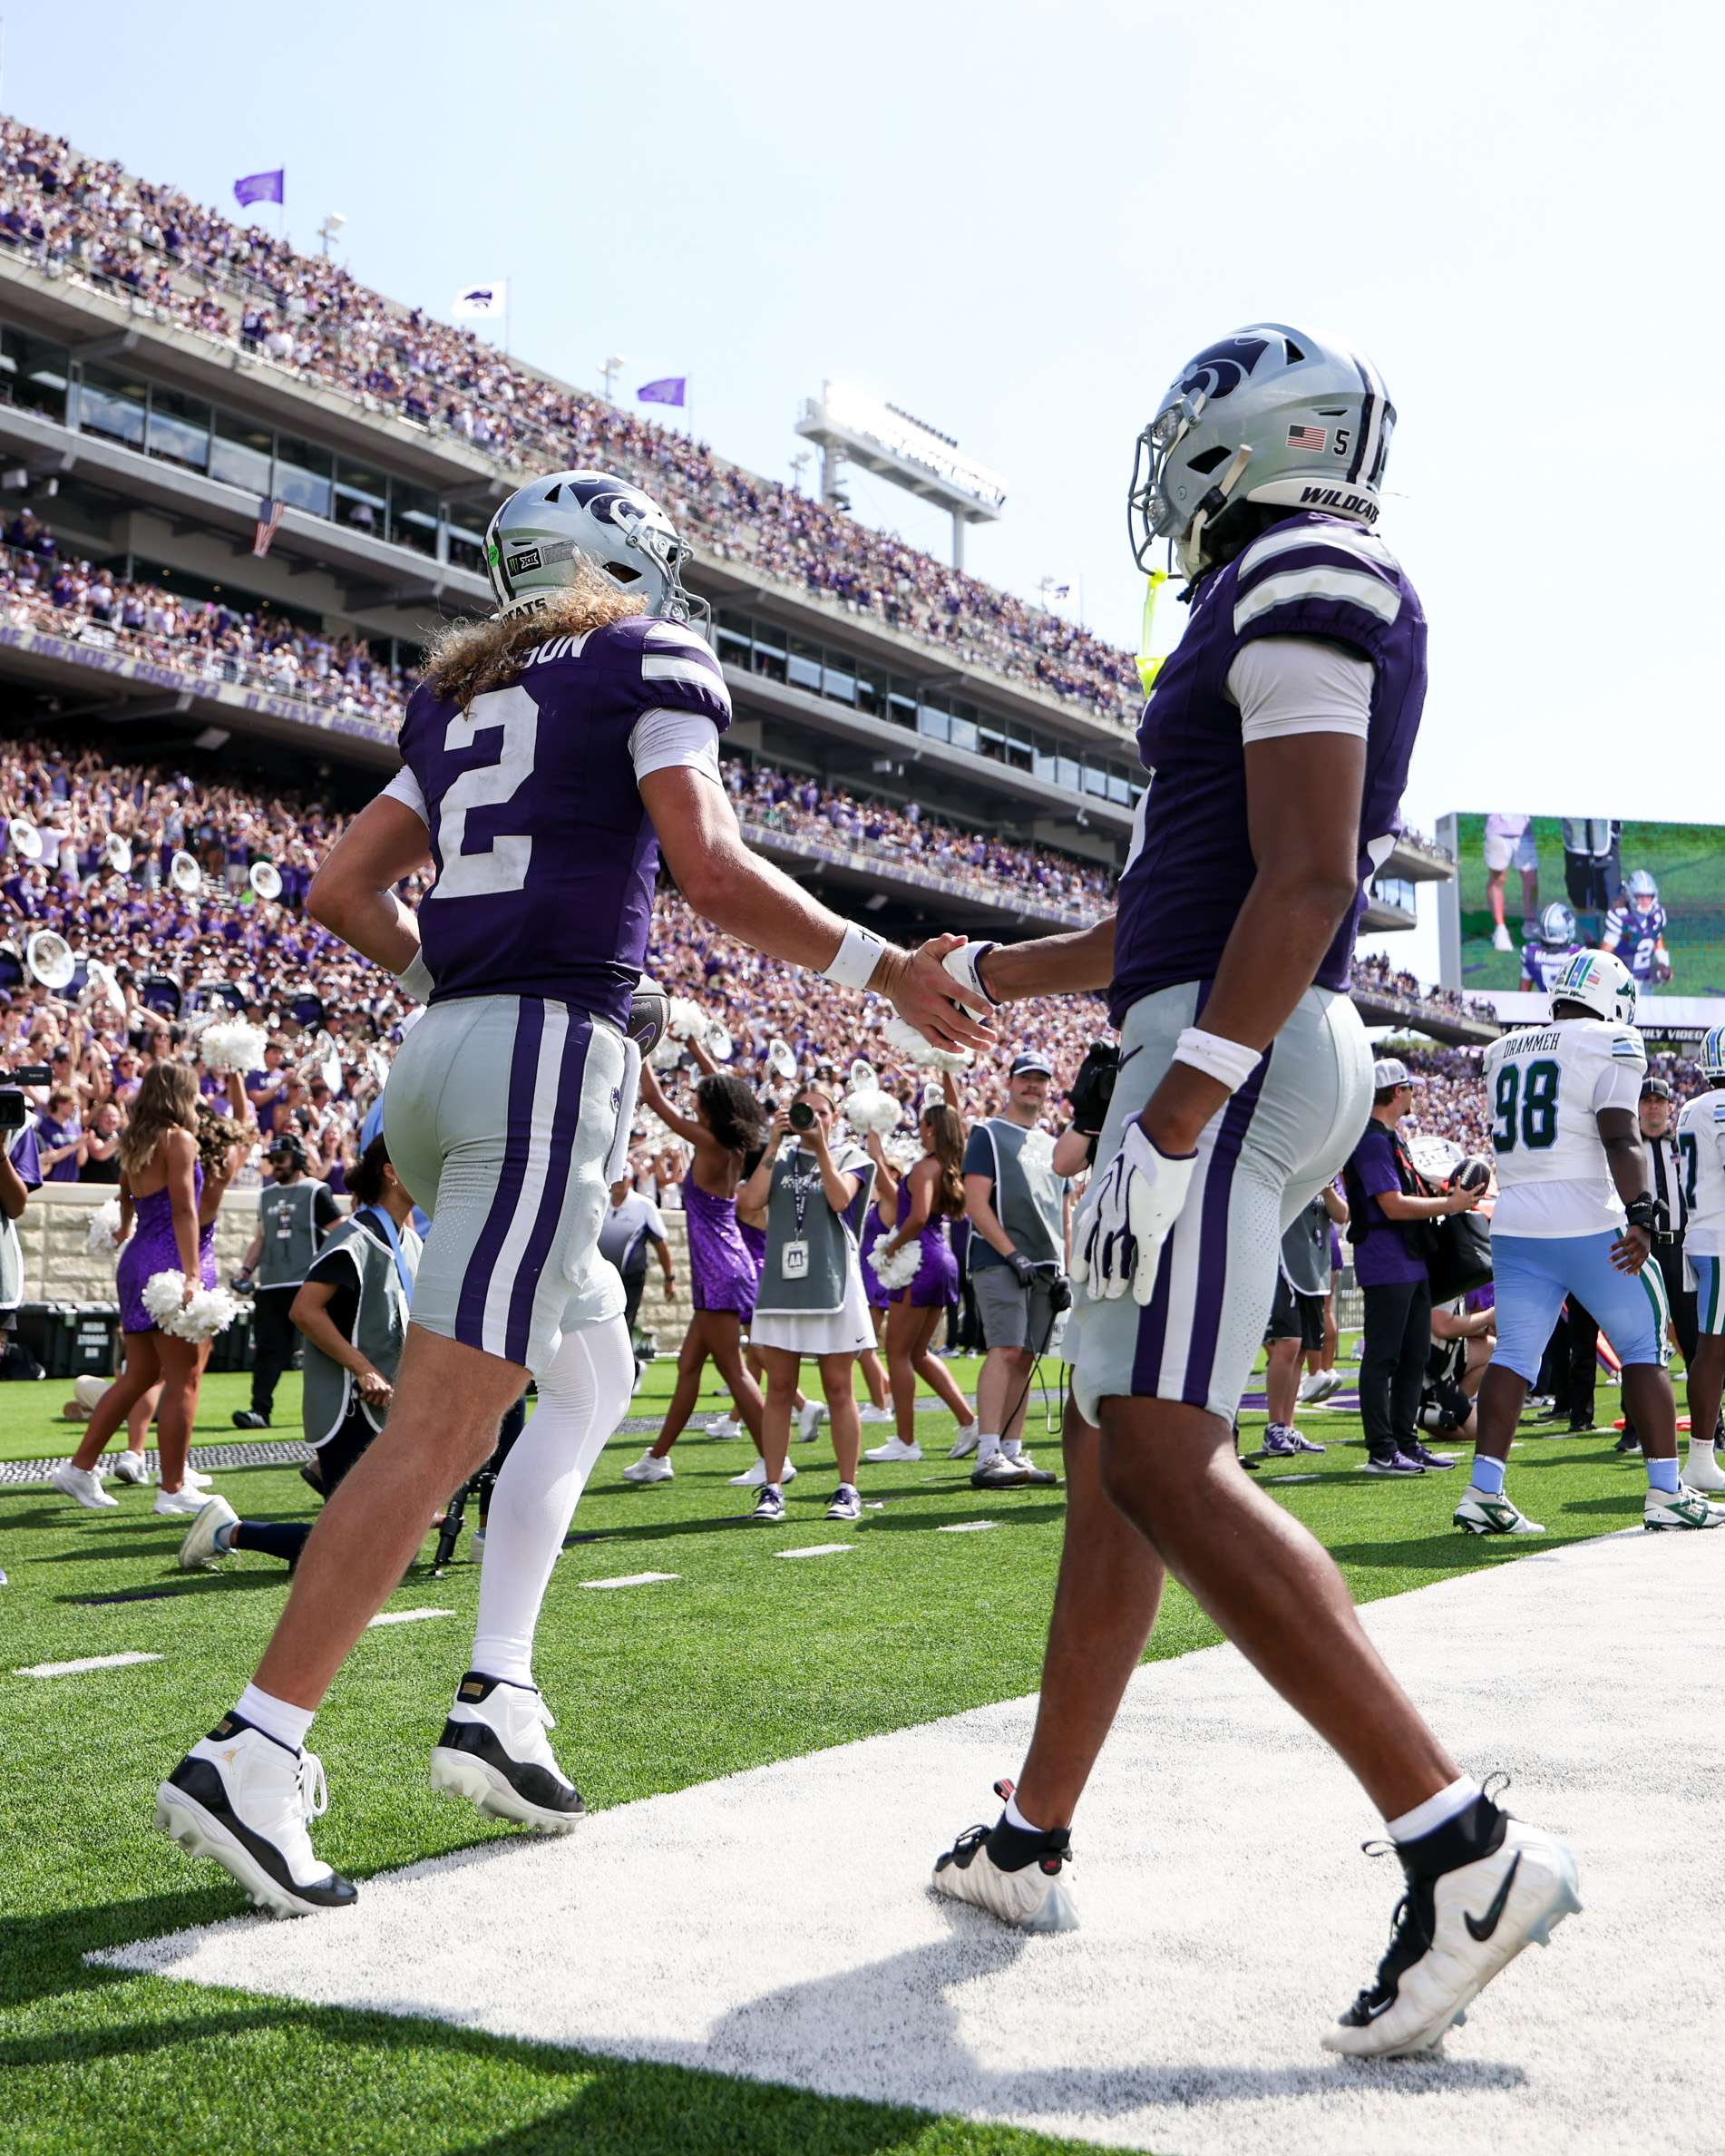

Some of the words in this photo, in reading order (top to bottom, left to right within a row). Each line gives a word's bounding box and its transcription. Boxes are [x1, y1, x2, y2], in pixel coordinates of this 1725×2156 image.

[1333, 429, 1350, 455] 5
[430, 685, 540, 899] 2
[1633, 938, 1655, 970] 2
[1503, 1032, 1561, 1058] DRAMMEH
[1667, 1029, 1704, 1041] VIDEO
[1492, 1059, 1561, 1155] 98
